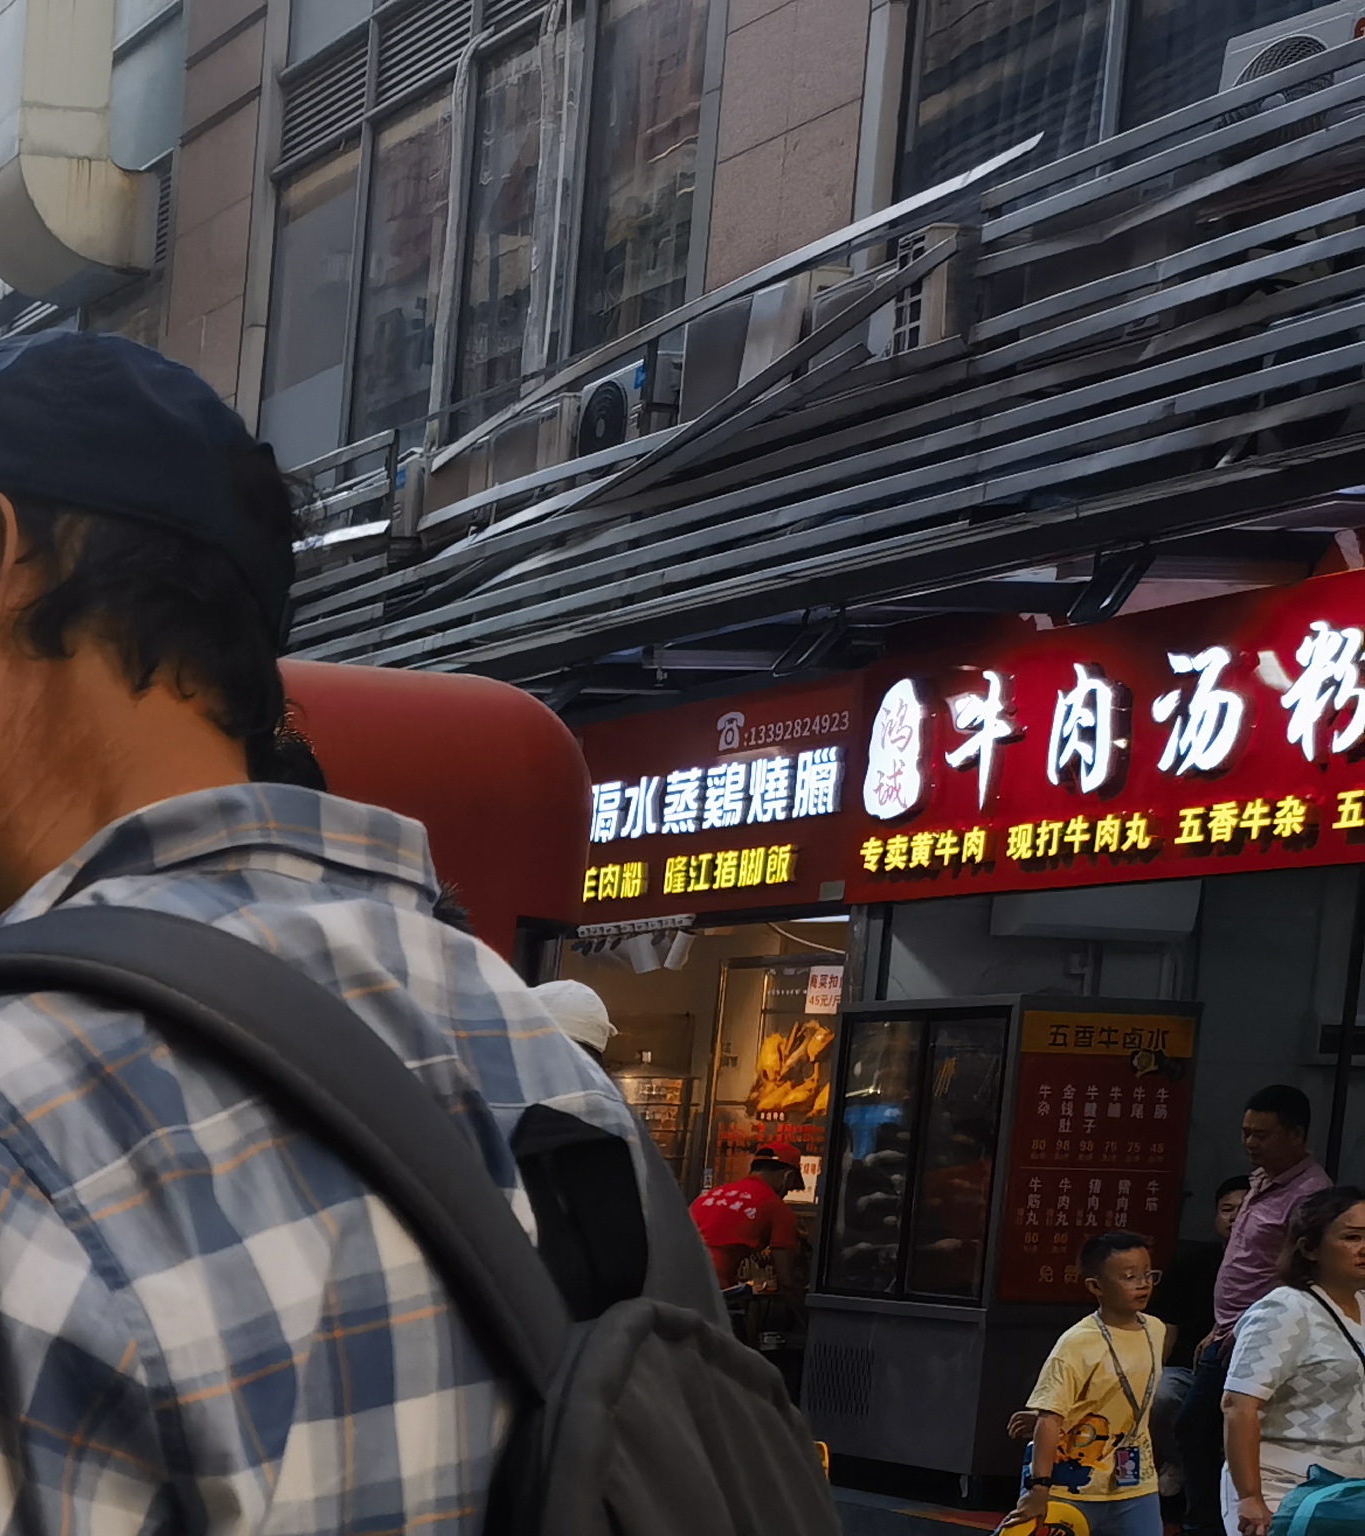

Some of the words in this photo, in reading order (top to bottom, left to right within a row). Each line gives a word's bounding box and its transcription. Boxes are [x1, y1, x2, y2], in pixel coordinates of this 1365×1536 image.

[945, 620, 1365, 811] 牛肉汤粉
[859, 825, 987, 873] 专卖黄牛肉
[1006, 812, 1151, 861] 现打牛肉丸
[1174, 795, 1308, 845] 五香牛杂
[1048, 1024, 1169, 1050] 五香牛卤水
